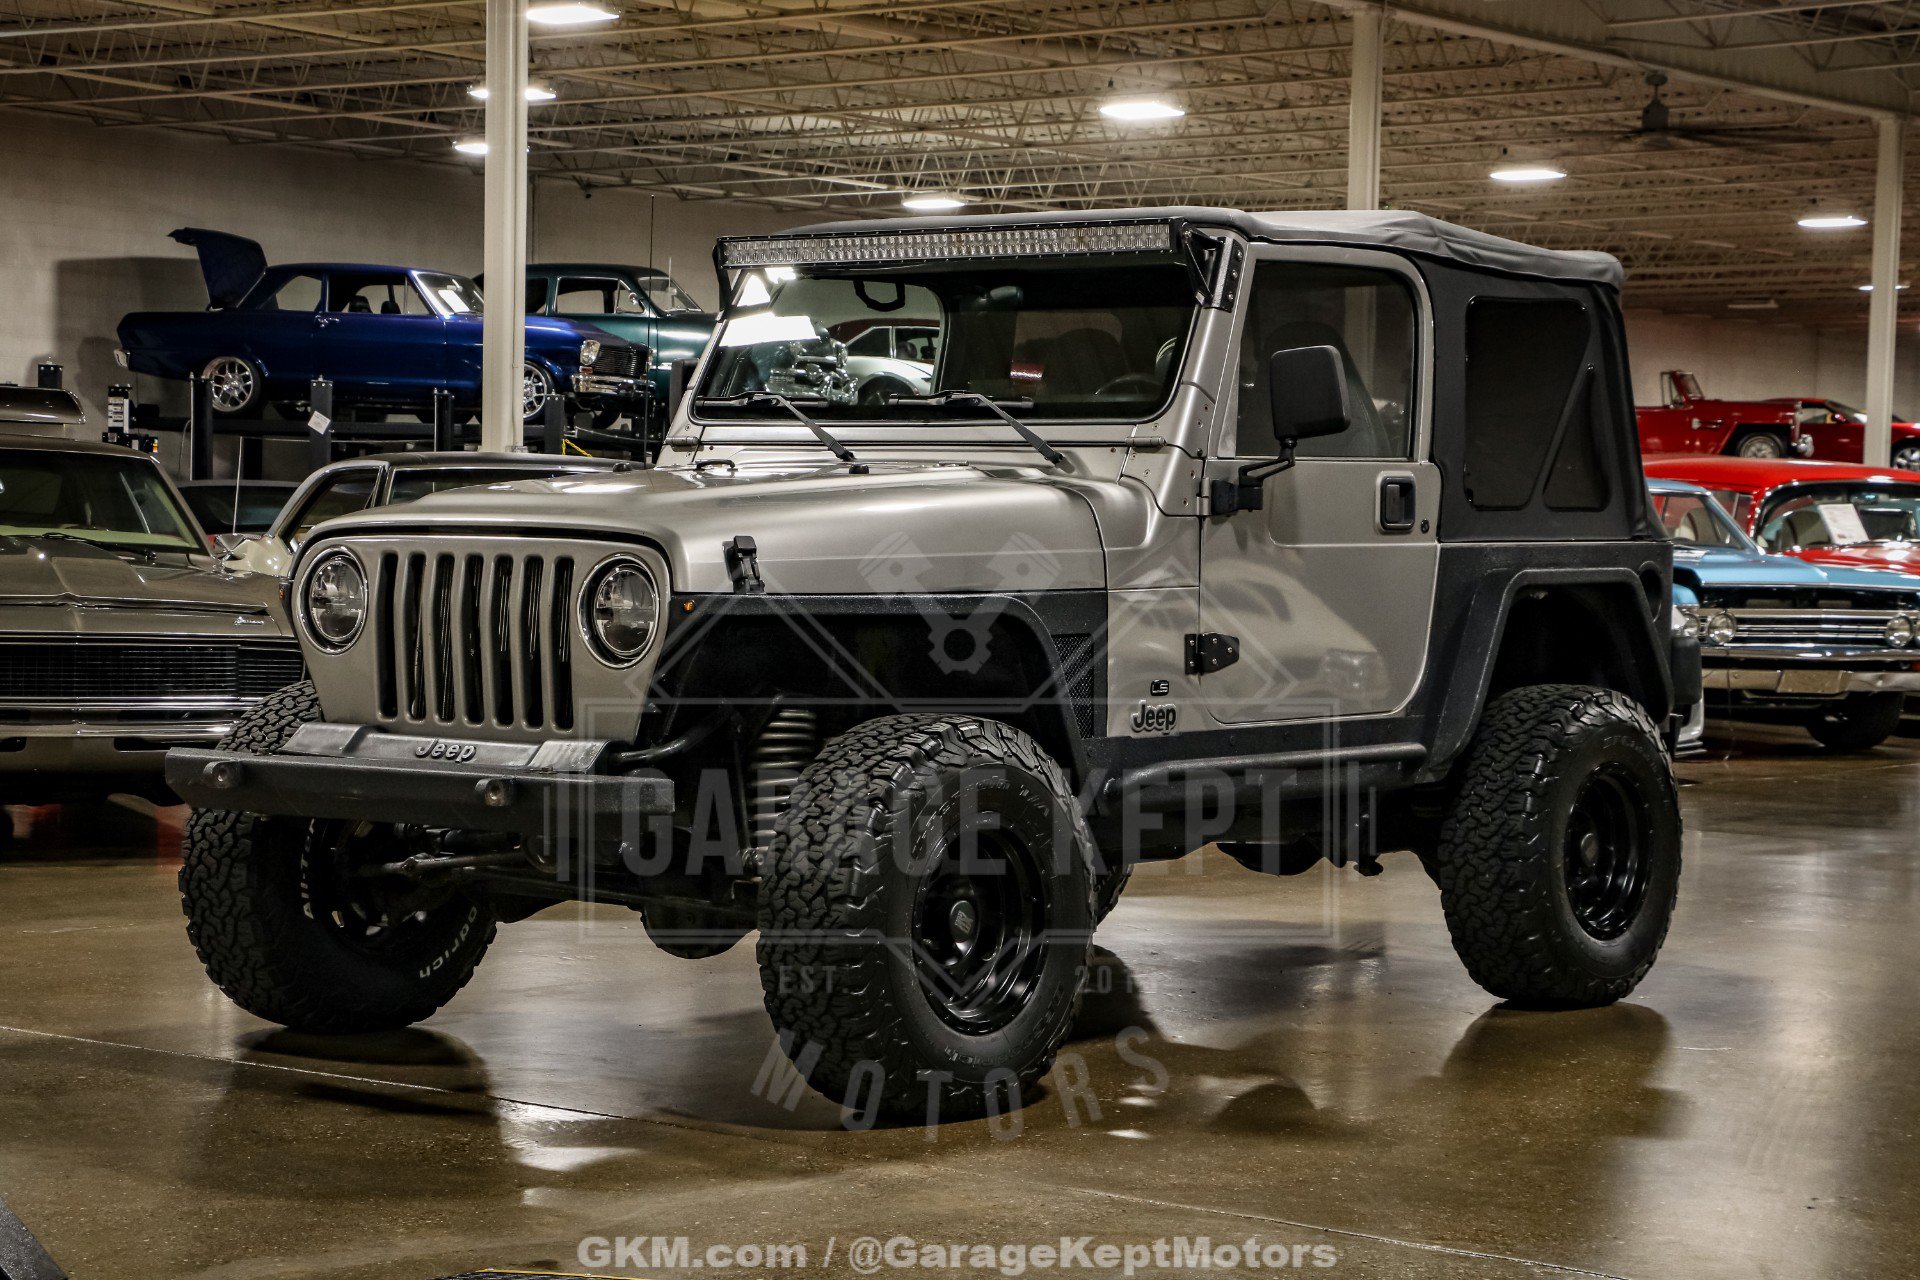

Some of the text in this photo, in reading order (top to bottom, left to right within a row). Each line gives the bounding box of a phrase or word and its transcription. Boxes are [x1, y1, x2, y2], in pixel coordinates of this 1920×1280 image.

[1131, 700, 1176, 733] Jeep
[415, 738, 477, 763] Jeep
[418, 905, 478, 979] odrich
